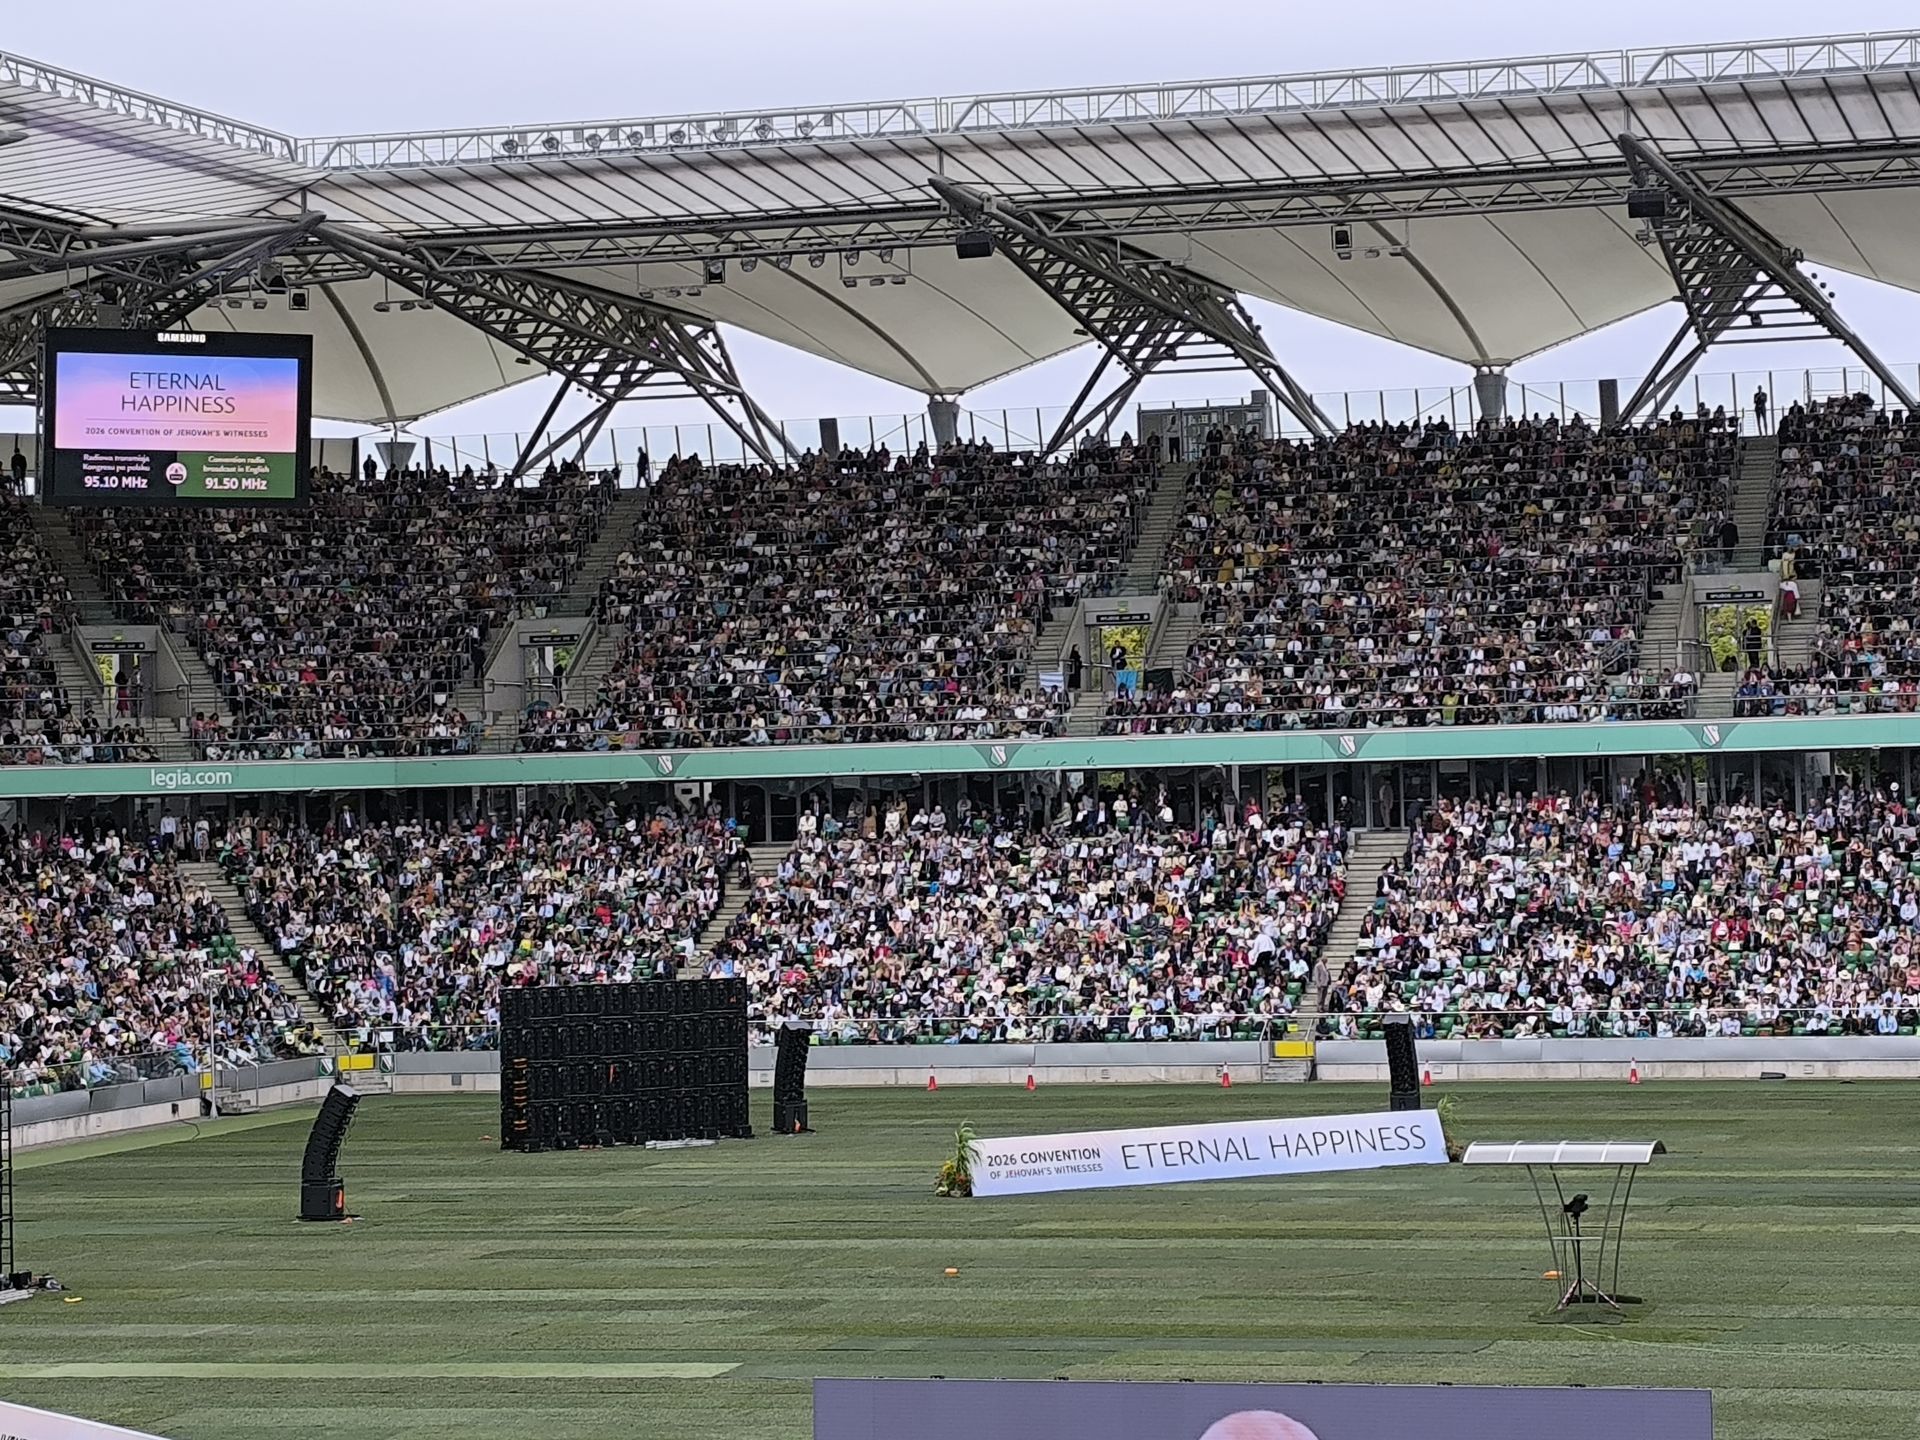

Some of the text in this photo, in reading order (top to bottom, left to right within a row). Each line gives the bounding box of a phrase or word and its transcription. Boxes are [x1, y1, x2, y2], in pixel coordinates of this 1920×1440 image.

[157, 332, 206, 343] SAMSUNG
[130, 371, 226, 391] ETERNAL
[121, 395, 235, 413] HAPPINESS
[85, 427, 105, 435] 2026
[108, 427, 160, 436] CONVENTION
[176, 429, 220, 437] JEHOVAH'S
[223, 430, 268, 438] WITNESSES
[84, 475, 148, 489] 95.10 MHz
[205, 477, 267, 490] 91.50 MHz
[150, 768, 233, 789] legia.com
[1121, 1124, 1427, 1170] ETERNAL HAPPINESS
[987, 1147, 1101, 1167] 2026 CONVENTION
[989, 1163, 1104, 1180] OF JEHOVAH'S WITNESSES
